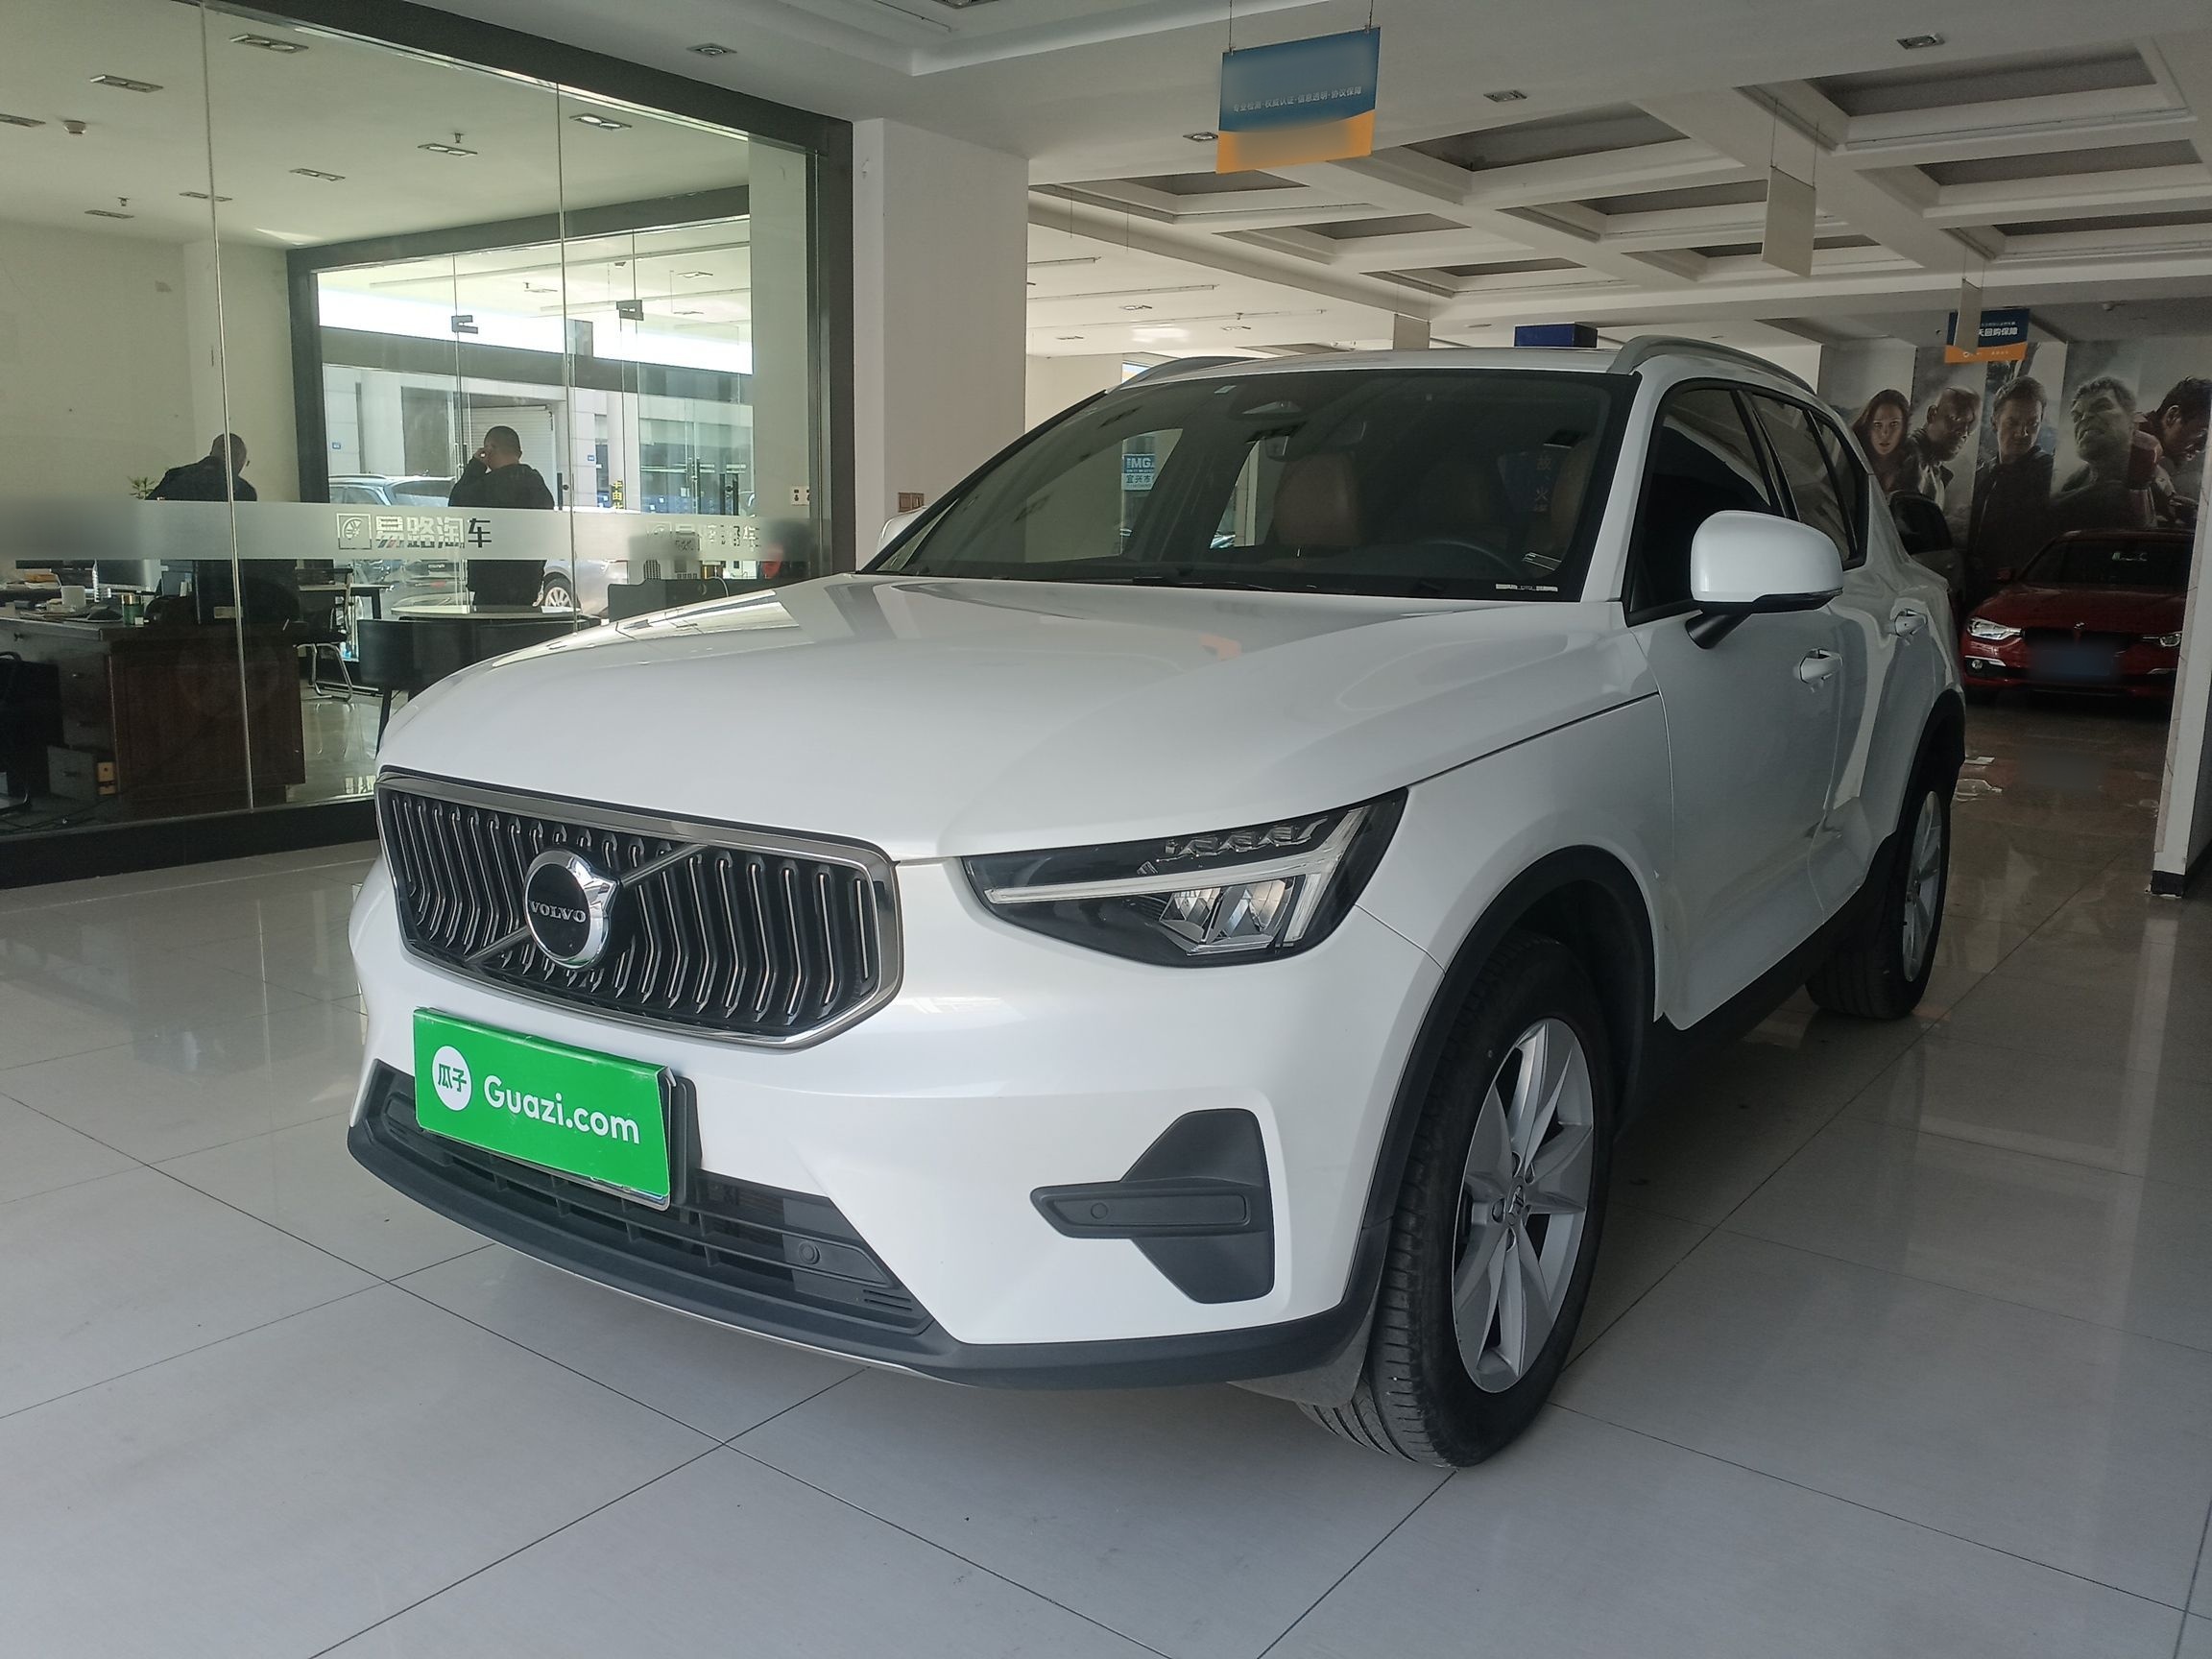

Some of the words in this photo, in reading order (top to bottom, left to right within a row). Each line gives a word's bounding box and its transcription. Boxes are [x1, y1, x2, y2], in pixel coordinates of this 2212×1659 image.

[375, 516, 493, 550] 易路淘车
[528, 899, 587, 923] VOLVO
[437, 1062, 467, 1093] 瓜子
[483, 1074, 640, 1144] Guazi.com
